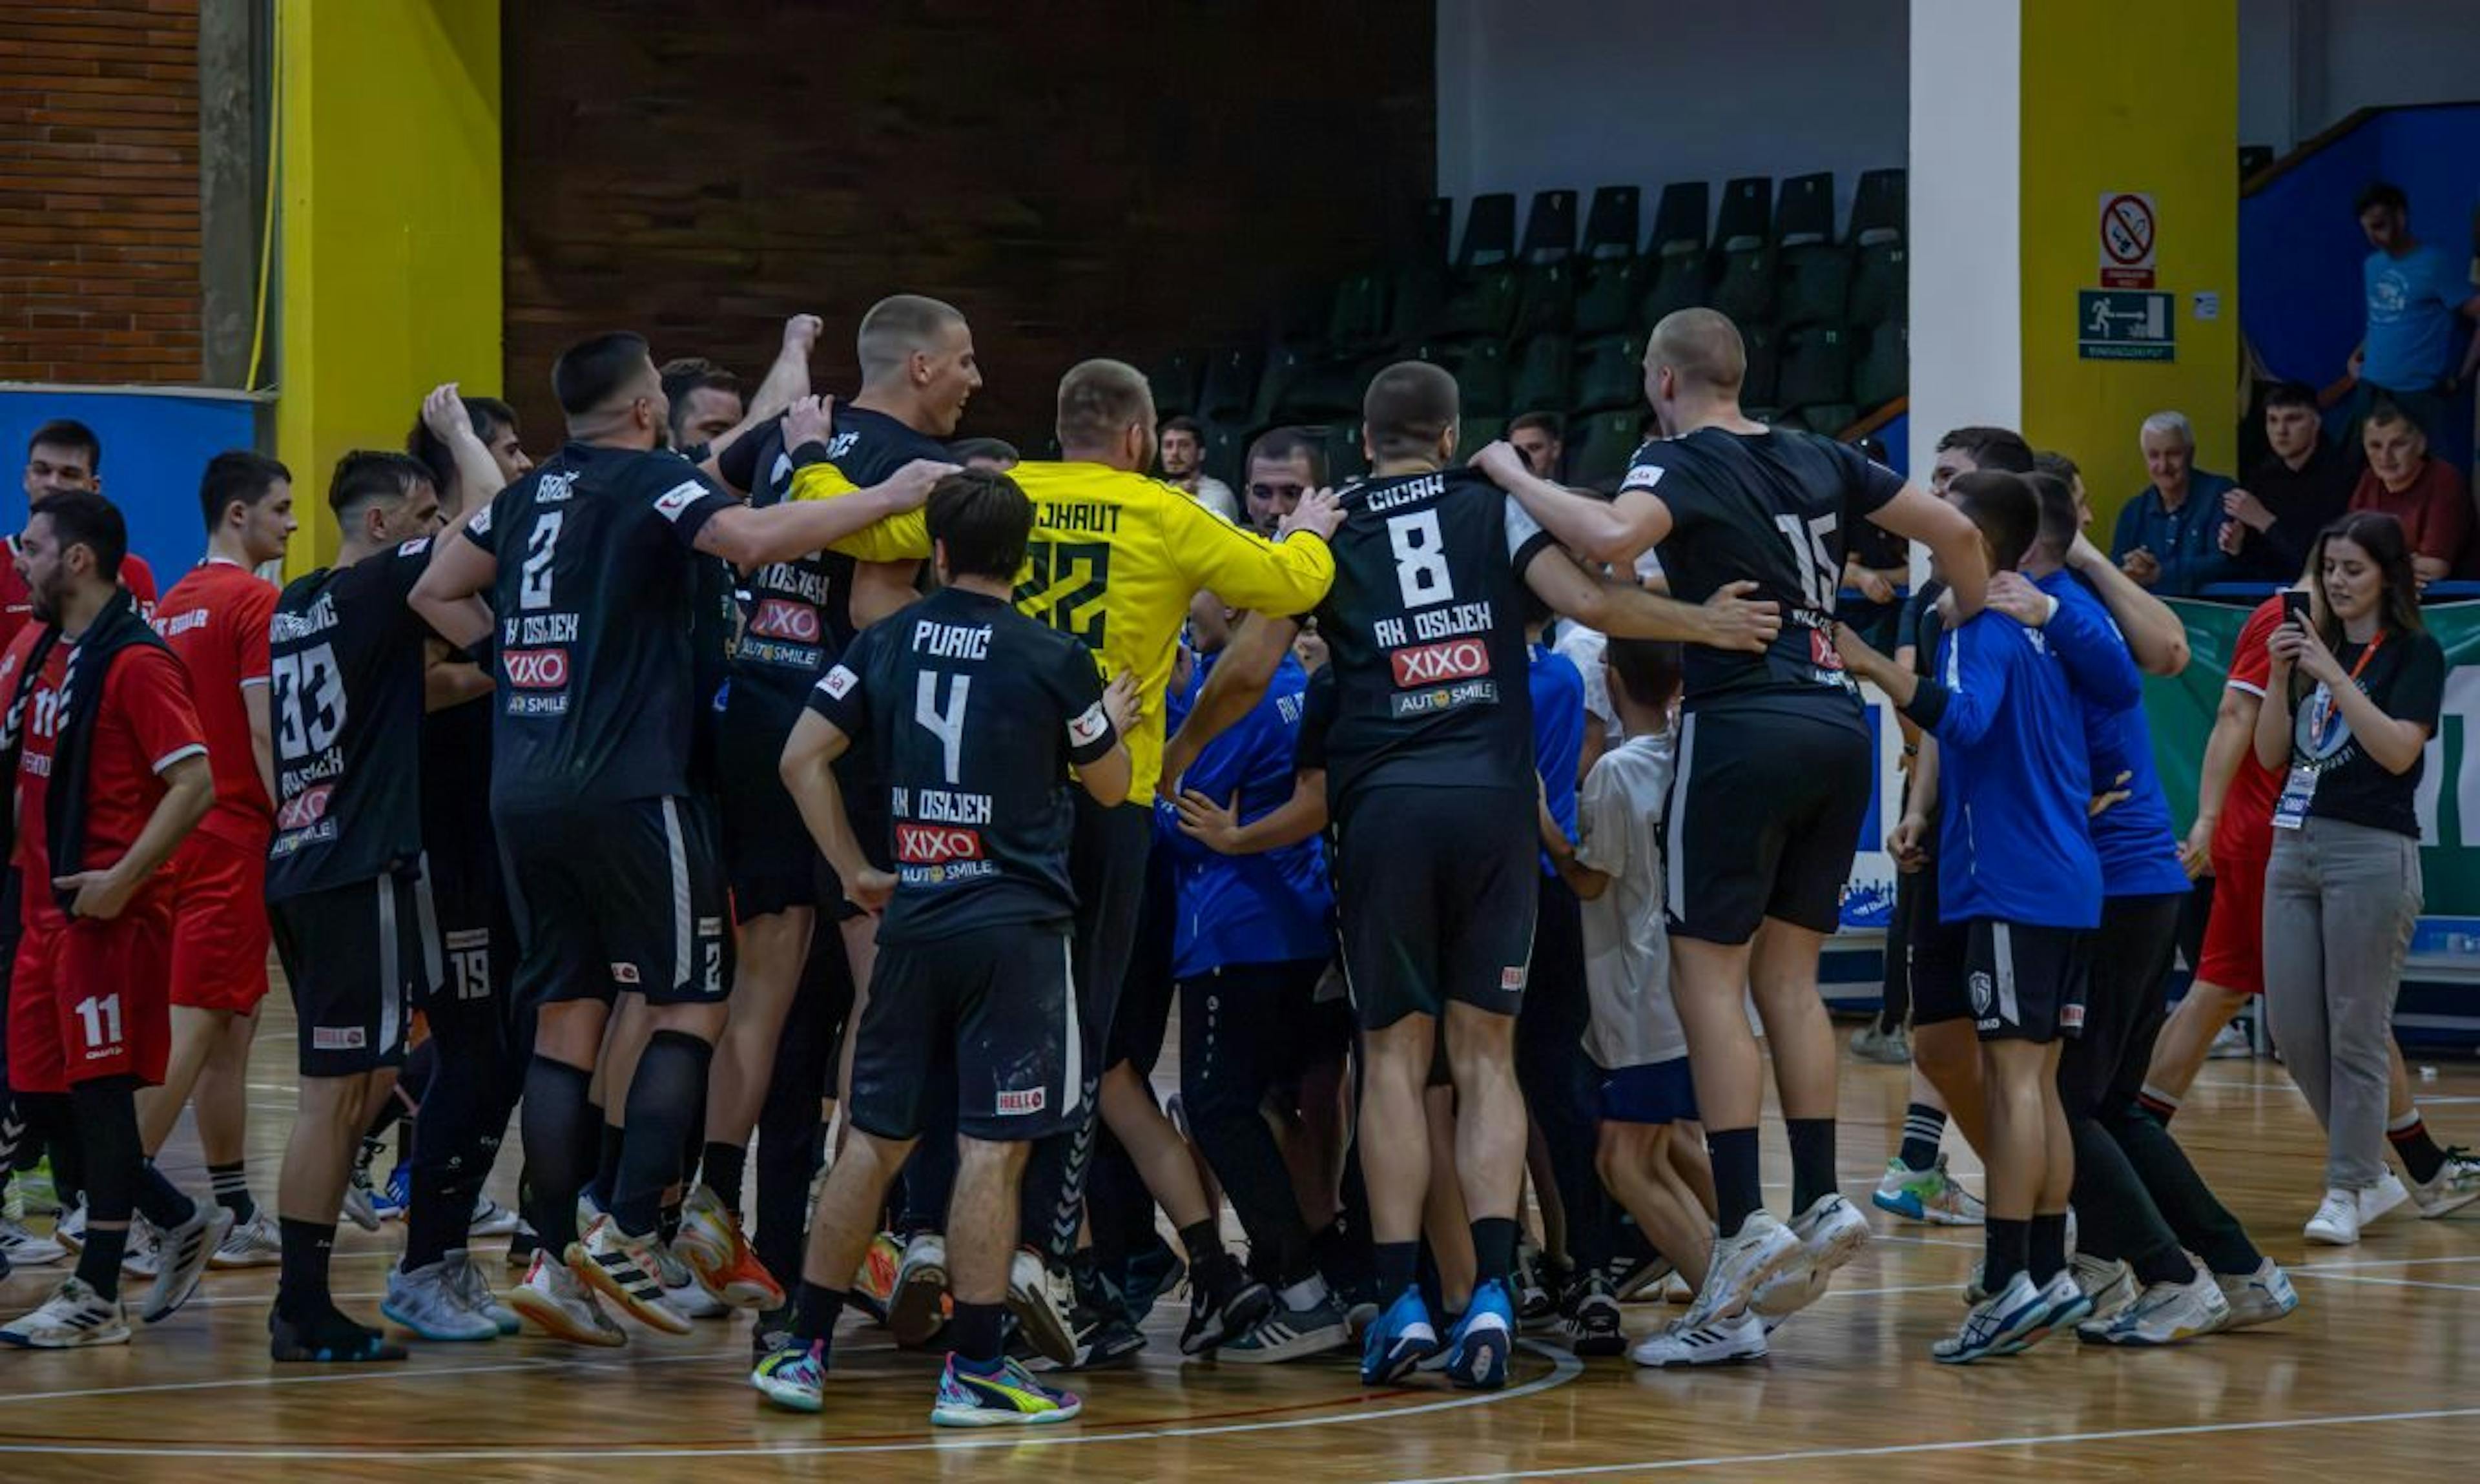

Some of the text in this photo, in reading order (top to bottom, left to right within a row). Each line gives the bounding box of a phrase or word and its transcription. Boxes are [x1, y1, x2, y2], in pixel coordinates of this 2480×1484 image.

[519, 510, 564, 610] 2
[767, 561, 831, 606] OSJEK
[1385, 507, 1454, 610] 8
[1774, 512, 1840, 615] 15
[1012, 541, 1110, 649] 22
[1413, 600, 1494, 641] OSIJEK
[522, 612, 580, 644] OSIJEK
[1400, 643, 1482, 682] XIXO
[271, 641, 347, 761] 33
[915, 668, 971, 785] 4
[918, 788, 993, 825] OSIJEK
[902, 827, 975, 860] XIXO
[450, 949, 491, 1000] 19
[704, 942, 721, 993] 2
[75, 992, 124, 1047] 11
